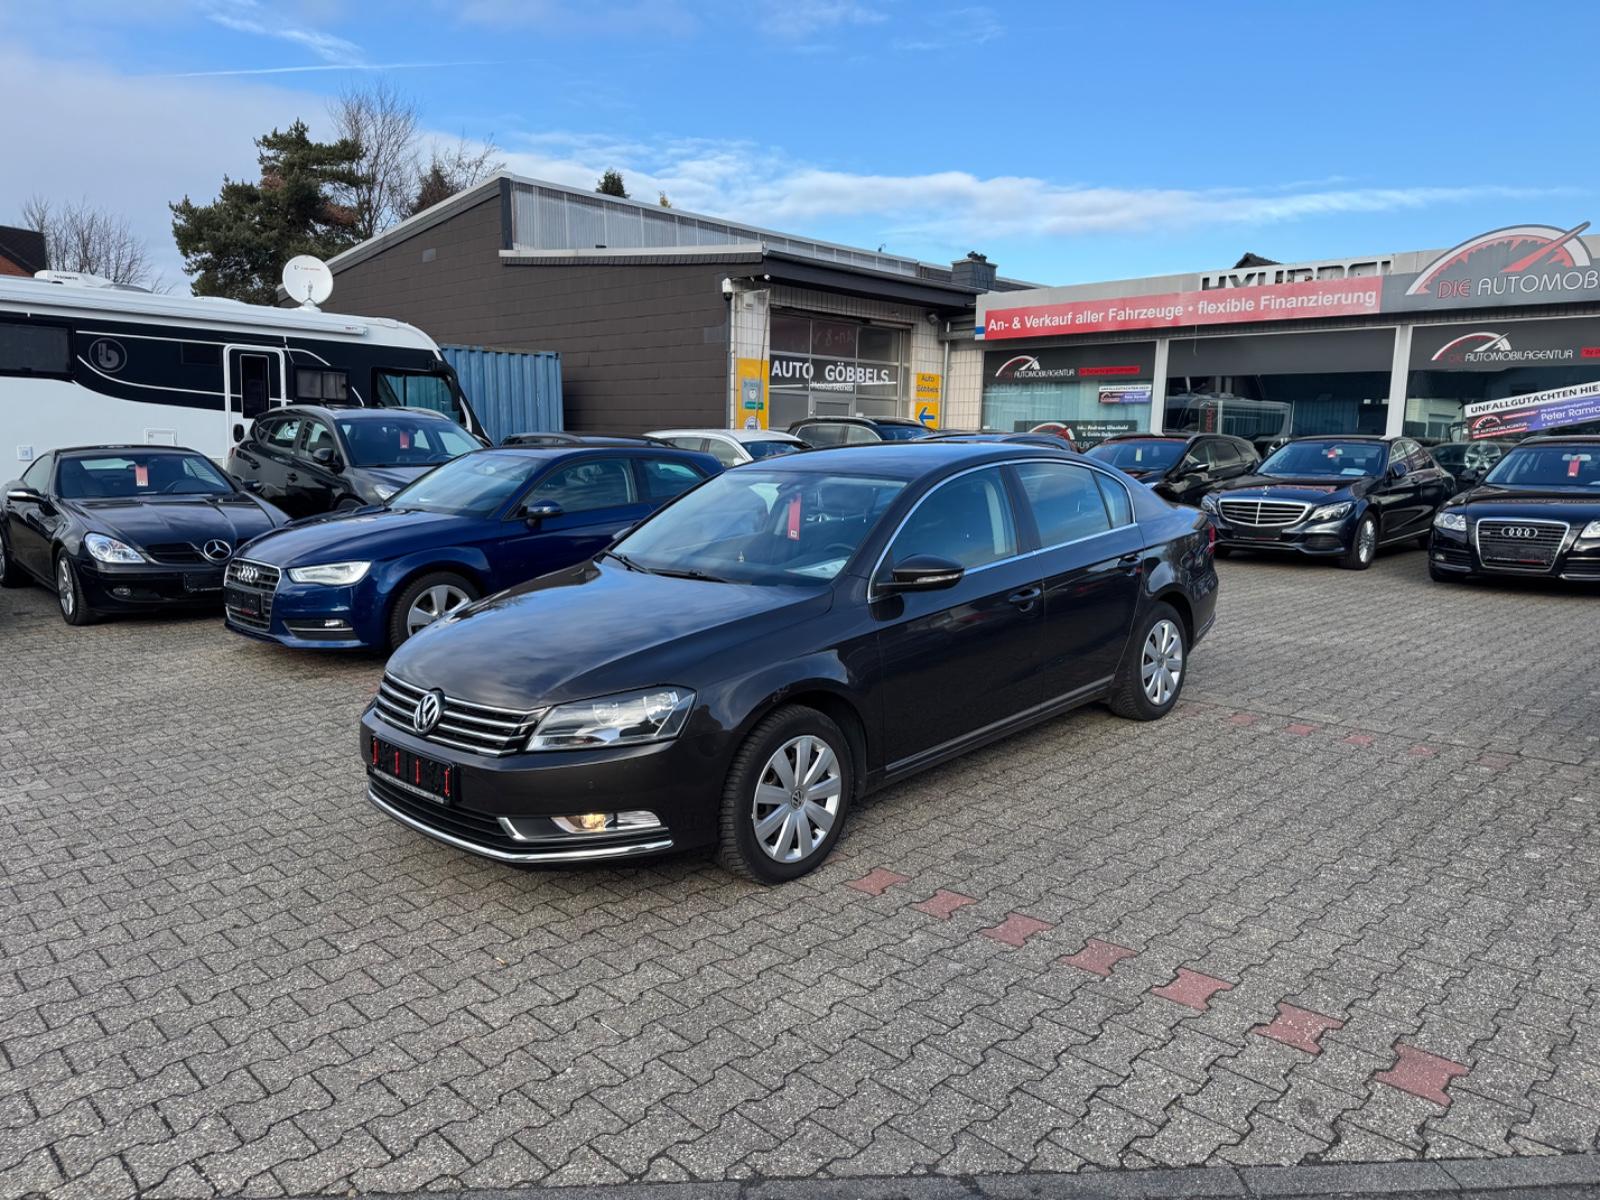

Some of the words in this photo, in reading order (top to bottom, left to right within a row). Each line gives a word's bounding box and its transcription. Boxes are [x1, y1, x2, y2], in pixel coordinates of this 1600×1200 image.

[1438, 279, 1470, 298] DIE
[1477, 270, 1599, 296] AUTOMOB
[988, 319, 1009, 331] An-
[1012, 316, 1022, 329] &
[1024, 312, 1072, 328] Verkauf
[1075, 310, 1104, 324] aller
[1108, 303, 1184, 321] Fahrzeuge
[1198, 297, 1255, 314] flexible
[1260, 290, 1377, 310] Finanzierung
[1464, 349, 1573, 362] AUTOMOBILAGENTUR
[771, 360, 814, 379] AUTO
[825, 362, 889, 383] GÖBBELS
[1470, 388, 1577, 414] UNFALLGUTACHTEN
